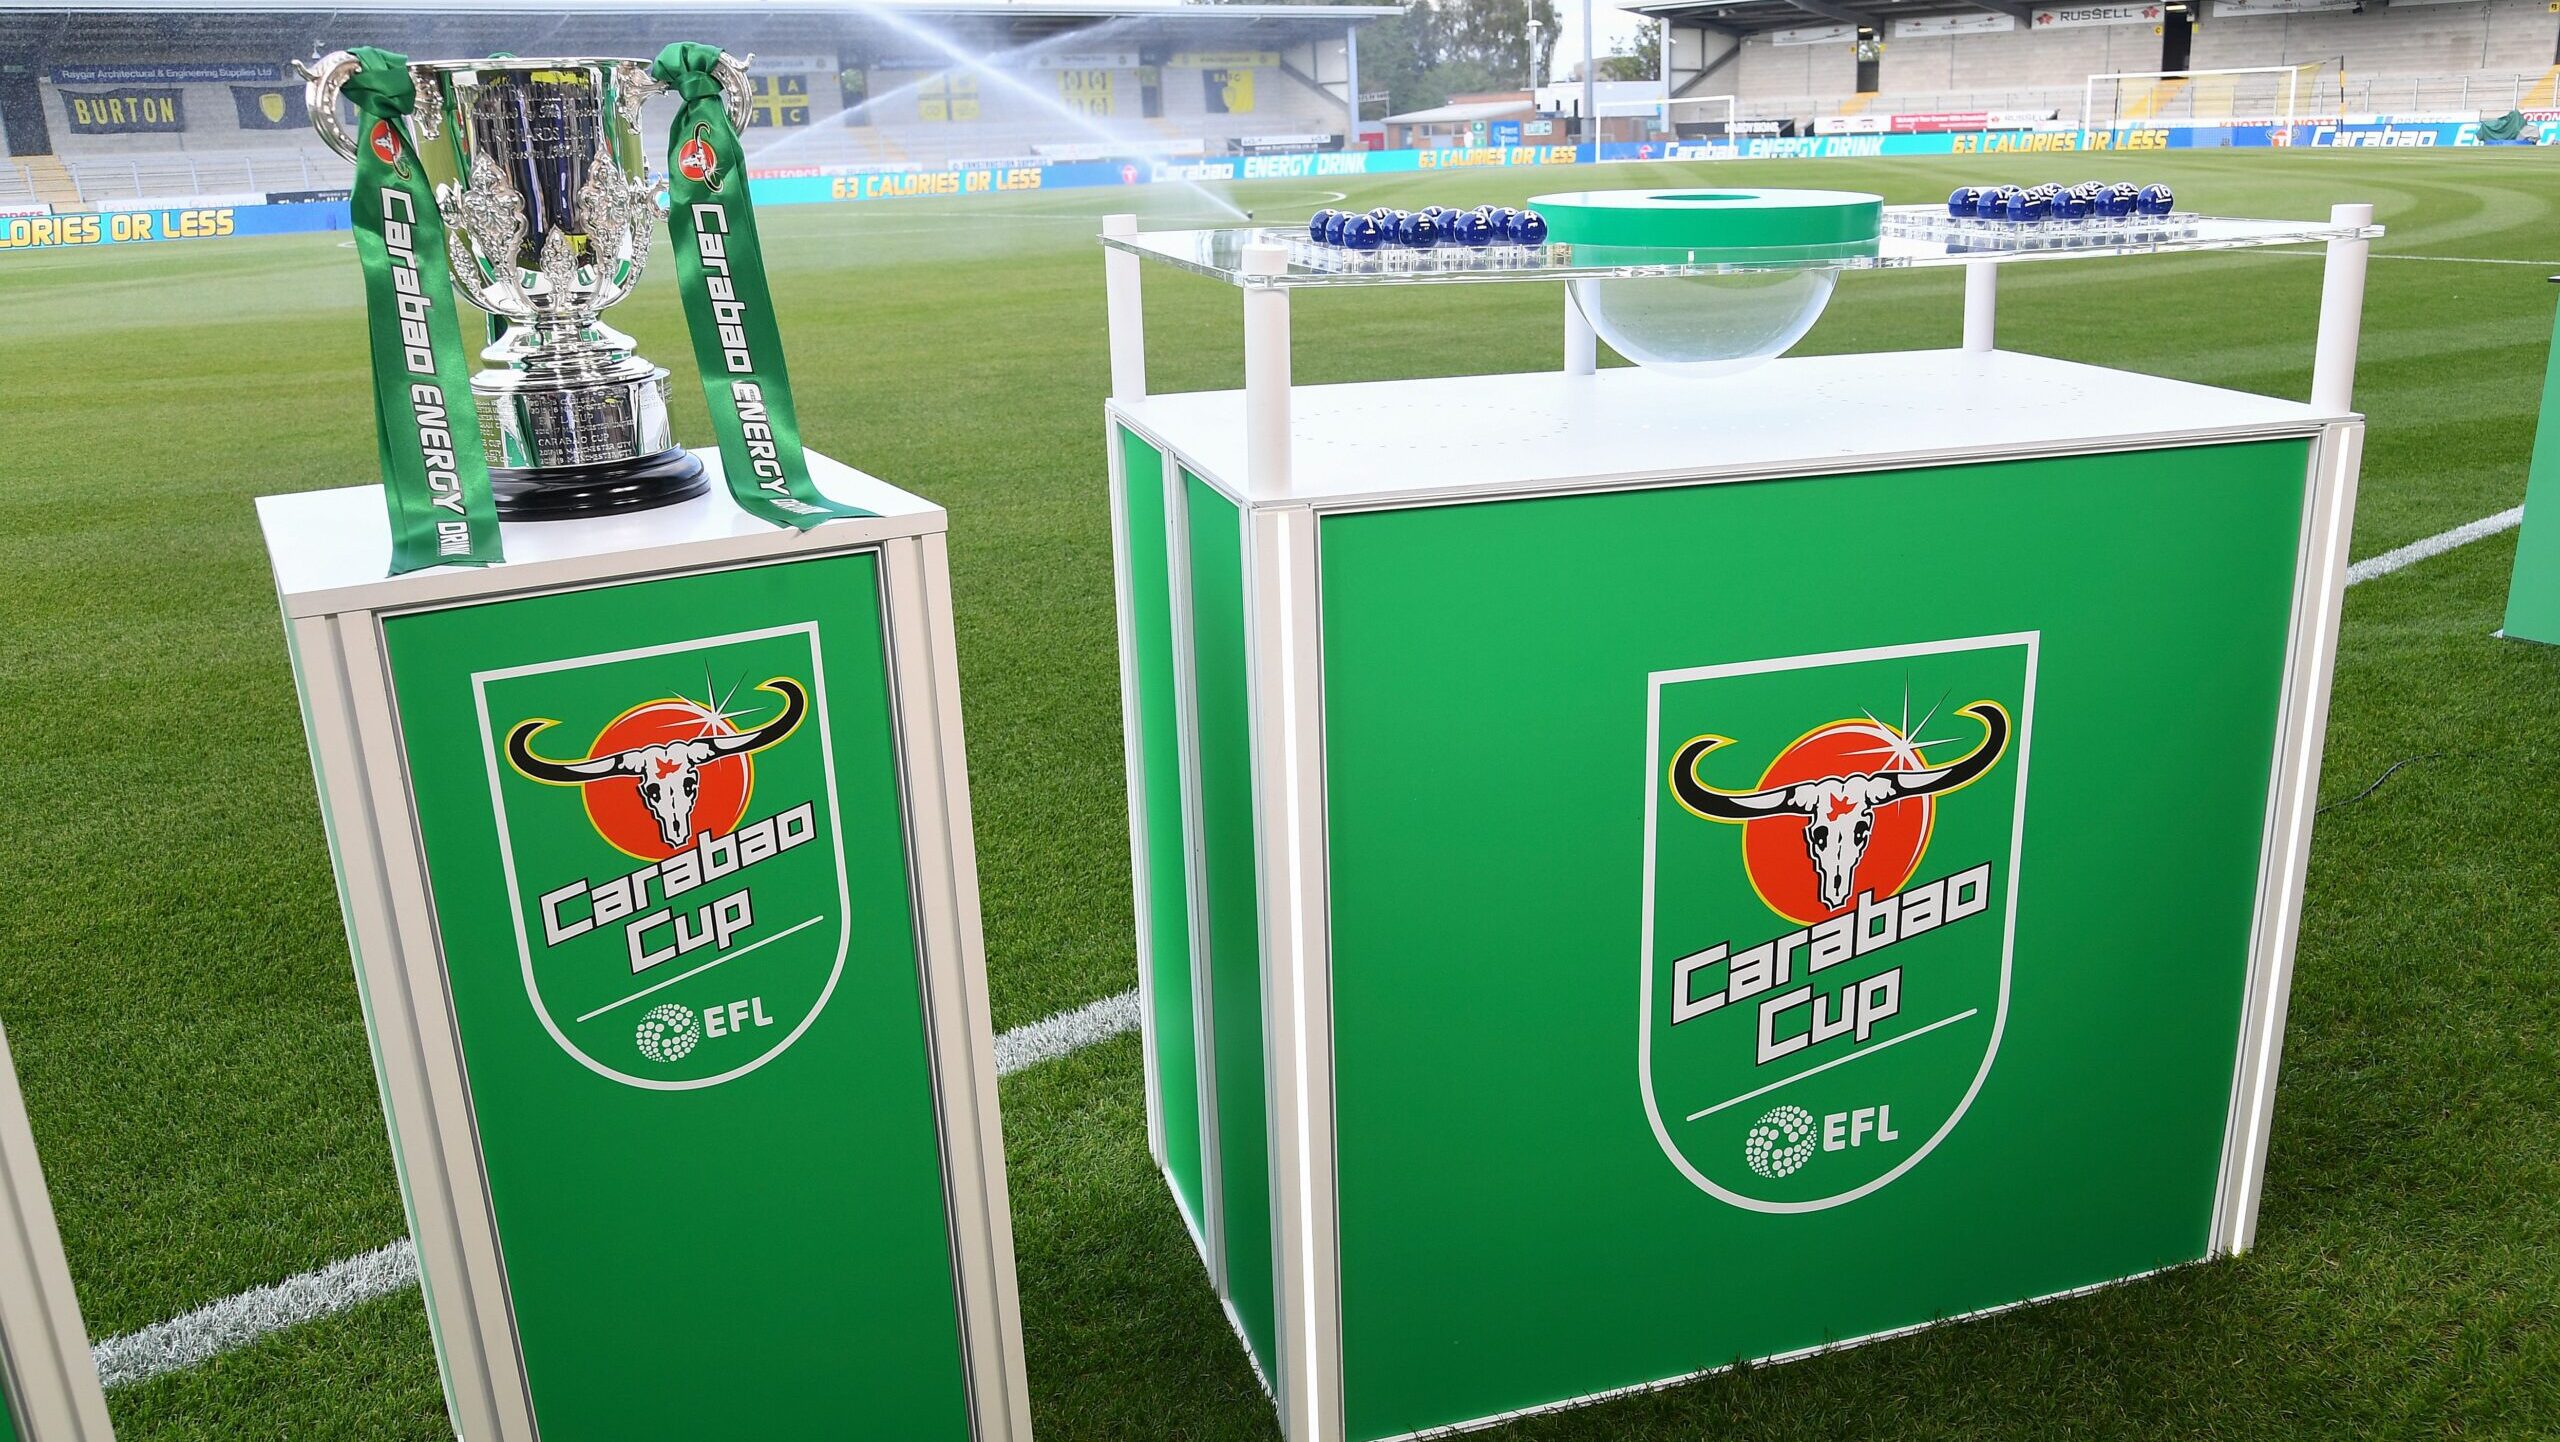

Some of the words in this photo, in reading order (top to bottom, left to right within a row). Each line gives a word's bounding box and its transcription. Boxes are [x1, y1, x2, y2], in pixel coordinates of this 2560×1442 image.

[2060, 8, 2133, 21] RUSSELL
[97, 69, 156, 79] Architectural
[157, 69, 164, 78] &
[166, 68, 219, 80] Engineering
[219, 68, 255, 79] Supplies
[257, 67, 272, 77] Ltd
[787, 79, 799, 93] A
[74, 96, 176, 125] BURTON
[790, 109, 801, 122] C
[1749, 138, 1822, 160] ENERGY
[1825, 135, 1887, 158] DRINK
[1951, 134, 1978, 154] 63
[1983, 131, 2077, 154] CALORIES
[2114, 129, 2170, 151] LESS
[2310, 124, 2439, 148] Carabao
[1151, 160, 1235, 183] Carabao
[1243, 154, 1314, 178] ENERGY
[1317, 151, 1367, 176] DRINK
[1418, 149, 1437, 169] 63
[1440, 147, 1506, 168] CALORIES
[1511, 147, 1537, 166] OR
[1540, 145, 1578, 165] LESS
[831, 177, 859, 200] 63
[866, 172, 960, 197] CALORIES
[965, 170, 990, 192] OR
[996, 167, 1043, 190] LESS
[2150, 185, 2171, 199] 16
[110, 213, 154, 243] OR
[162, 209, 235, 239] LESS
[380, 186, 437, 376] Carabao
[409, 381, 467, 516] ENERGY
[691, 203, 754, 375] Carabao
[730, 379, 791, 496] ENERGY
[539, 800, 817, 948] Carabao
[624, 887, 755, 976] Cup
[1671, 861, 1992, 1027] Carabao
[703, 996, 774, 1039] EFL
[1755, 965, 1903, 1067] Cup
[1822, 1103, 1899, 1152] EFL
